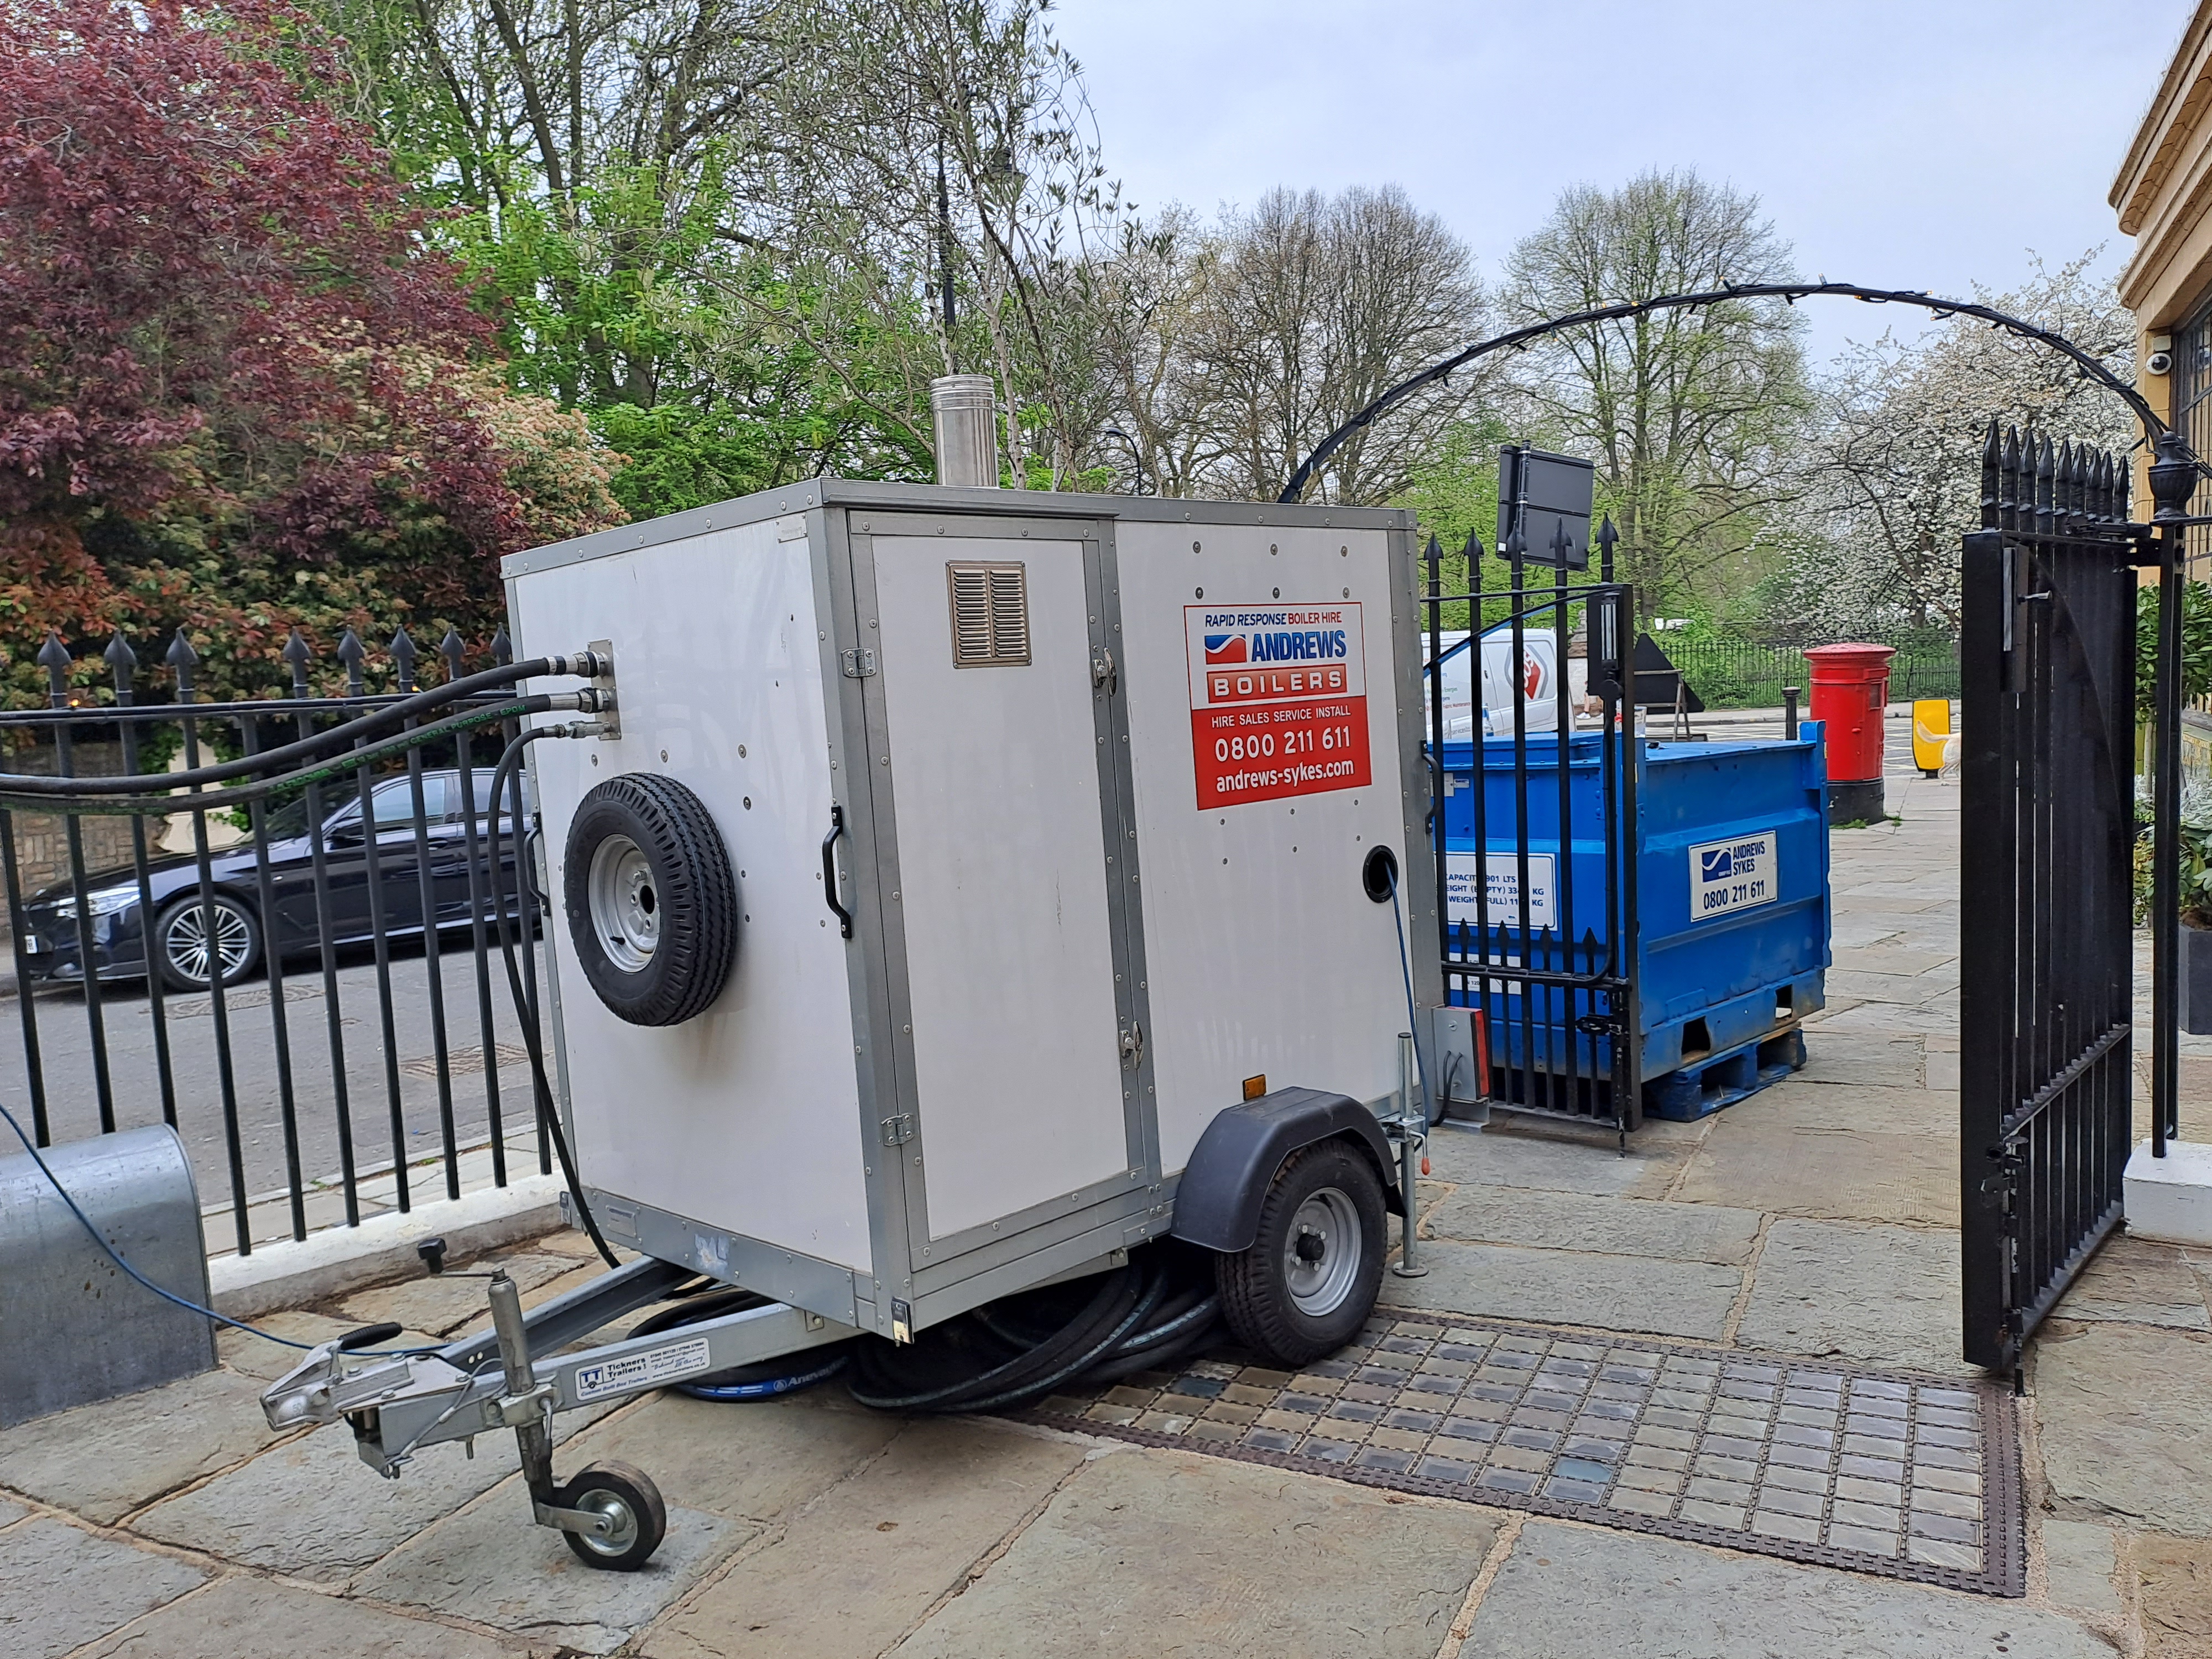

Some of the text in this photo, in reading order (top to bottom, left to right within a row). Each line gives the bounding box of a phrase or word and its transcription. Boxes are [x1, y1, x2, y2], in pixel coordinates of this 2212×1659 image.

[1206, 612, 1342, 627] RAPID RESPONSE BOILER HIRE
[1251, 630, 1347, 662] ANDREWS
[1214, 670, 1342, 697] BOILERS
[410, 727, 449, 744] GENERAL
[451, 712, 493, 729] PURPOSE
[500, 705, 525, 716] EPDM
[1212, 705, 1351, 728] HIRE SALES SERVICE INSTALL
[1215, 726, 1350, 762] 0800 211 611
[1217, 759, 1354, 792] andrews-sykes.com
[1733, 841, 1765, 860] ANDREWS
[1733, 858, 1755, 876] SYKES
[1471, 885, 1506, 895] (EPTY)
[1704, 880, 1765, 910] 0800 211 611
[581, 1369, 601, 1383] TT
[607, 1358, 646, 1371] Tickners
[1451, 1485, 1579, 1515] LONDON
